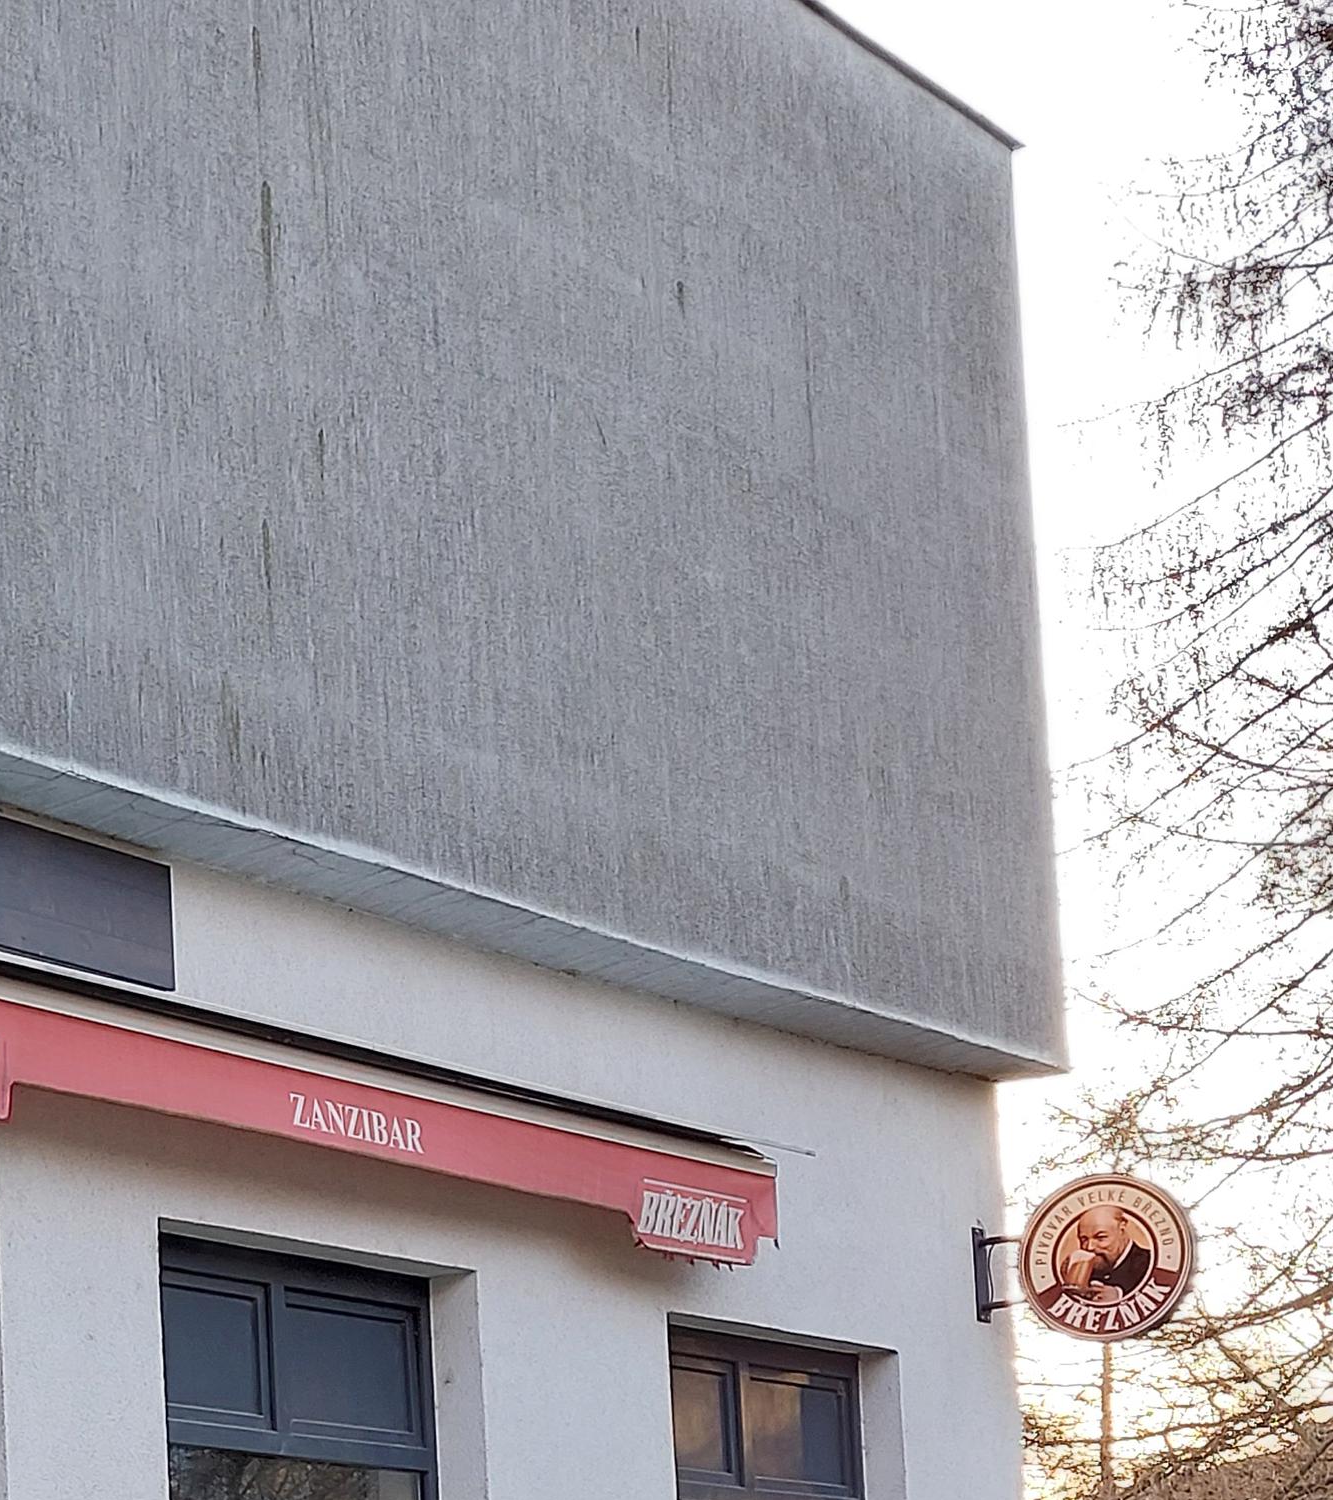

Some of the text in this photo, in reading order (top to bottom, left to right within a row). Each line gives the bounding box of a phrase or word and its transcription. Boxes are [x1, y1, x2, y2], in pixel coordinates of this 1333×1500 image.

[288, 1091, 427, 1155] ZANZIBAR
[636, 1189, 745, 1250] BŘEZŇÁK
[1035, 1188, 1175, 1266] PIVOVAR VELKÉ BŘEZNO
